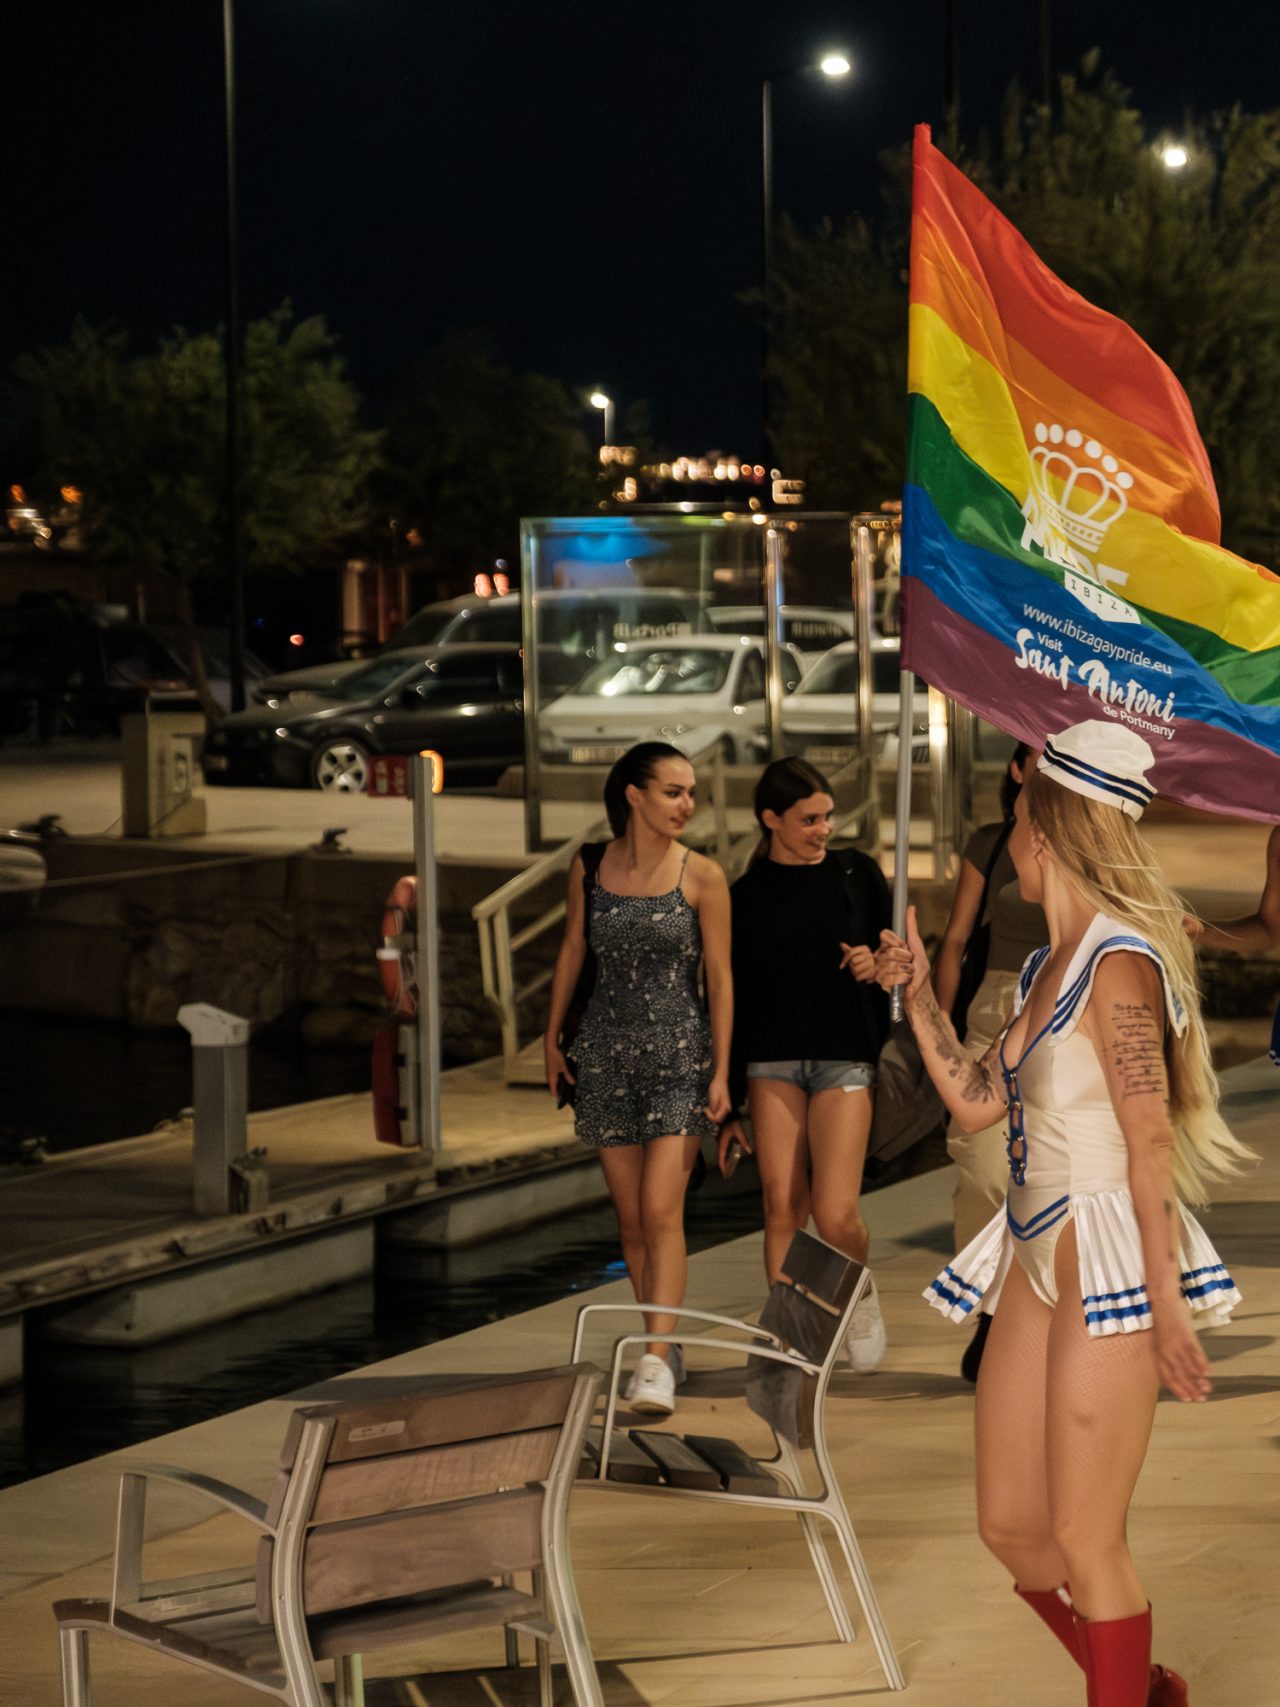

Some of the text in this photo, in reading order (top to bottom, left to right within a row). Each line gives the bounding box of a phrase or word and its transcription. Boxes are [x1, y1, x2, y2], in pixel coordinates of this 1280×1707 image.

[1071, 579, 1132, 616] IBIZA
[1023, 604, 1173, 675] www.ibizagaypride.eu
[1037, 632, 1063, 653] Visit
[1015, 628, 1176, 723] Sant Antoni
[1103, 705, 1176, 740] de Portmany
